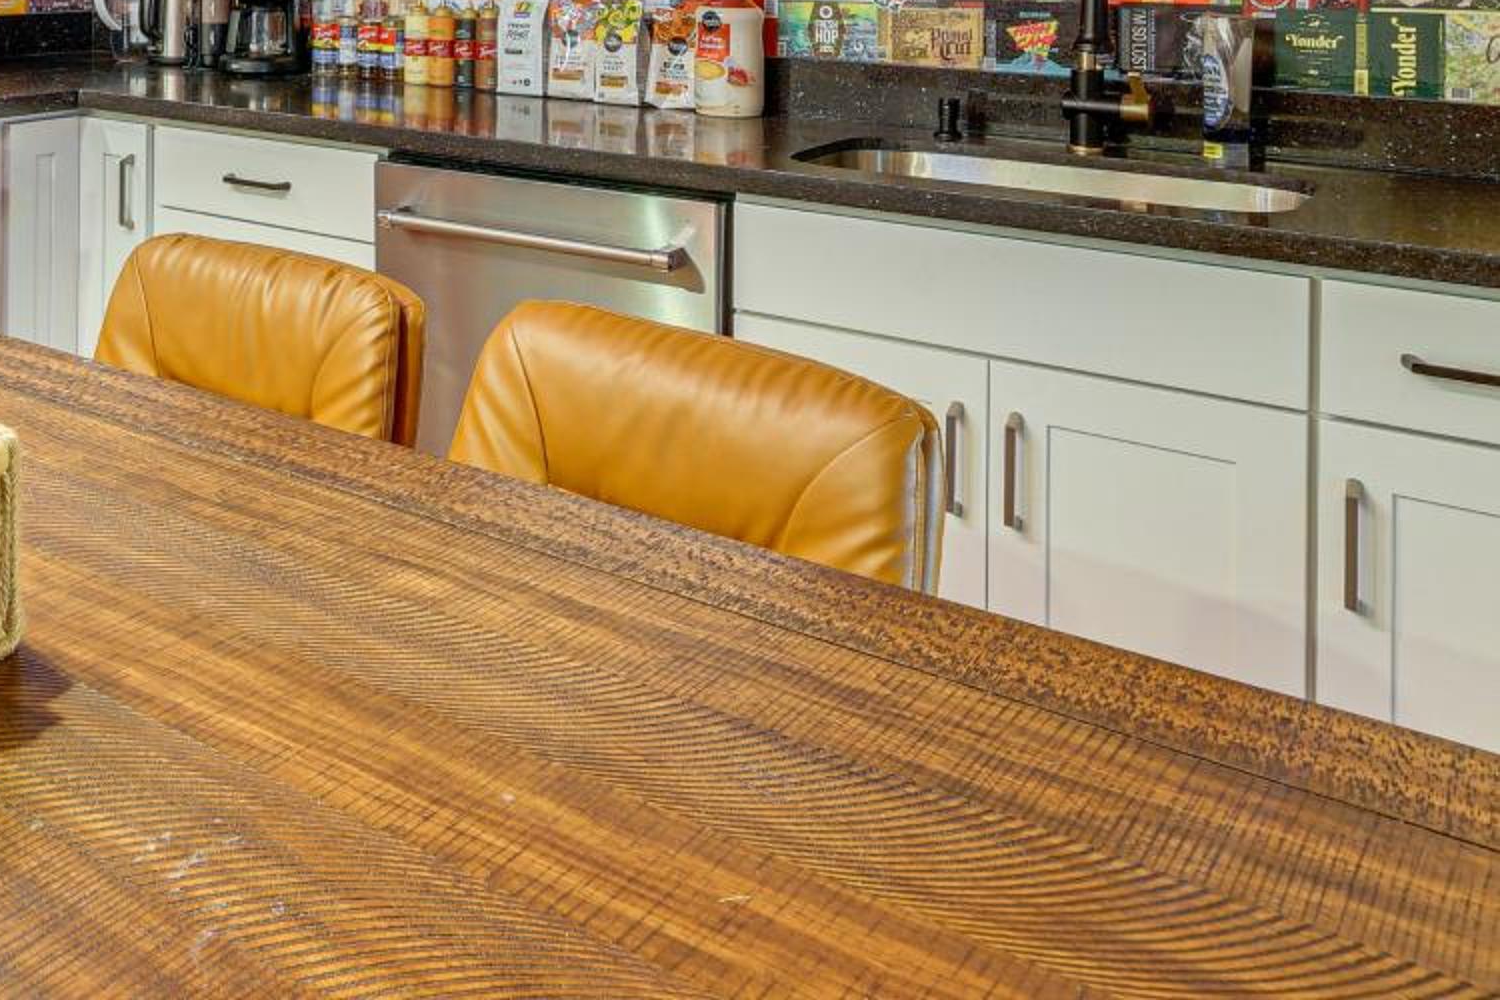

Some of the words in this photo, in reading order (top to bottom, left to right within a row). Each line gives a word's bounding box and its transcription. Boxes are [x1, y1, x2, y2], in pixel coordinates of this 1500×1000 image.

[815, 30, 838, 43] HOP
[1132, 27, 1146, 41] SO
[1285, 33, 1345, 49] Yonder
[1132, 43, 1146, 70] LOST
[1391, 16, 1417, 97] Yonder
